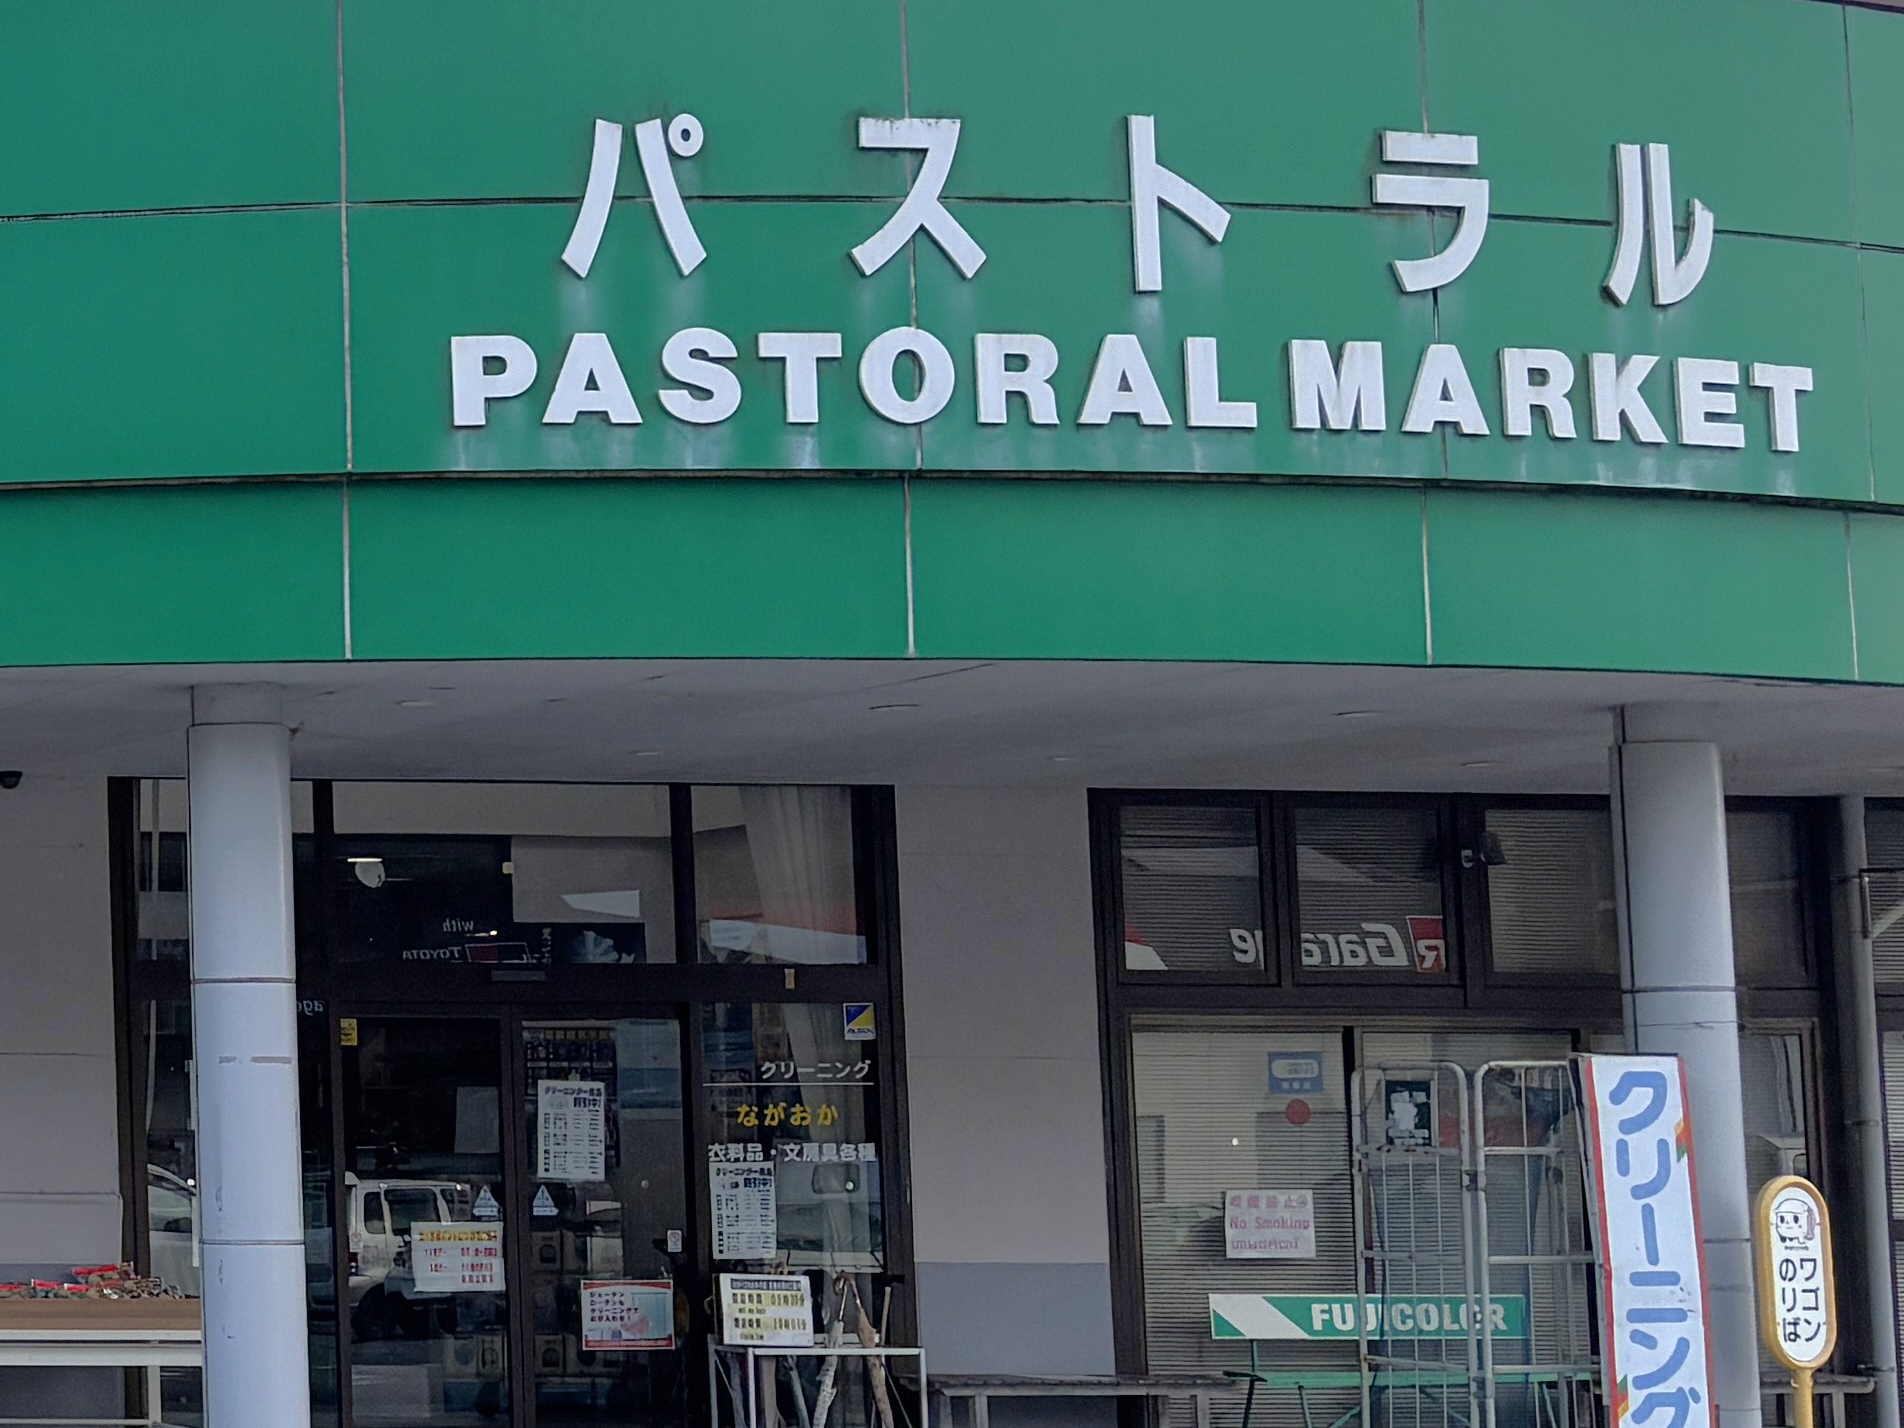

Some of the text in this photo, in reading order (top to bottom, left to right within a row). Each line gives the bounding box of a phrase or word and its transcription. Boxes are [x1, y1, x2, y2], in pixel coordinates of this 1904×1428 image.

[562, 113, 1715, 307] パストラル
[449, 326, 1813, 453] PASTORAL MARKET
[761, 1060, 872, 1079] クリーニング
[737, 1102, 839, 1127] ながおか
[1230, 1215, 1311, 1230] No Smoking
[1310, 1303, 1508, 1332] FUJICOLOR
[1779, 1257, 1802, 1343] のりば
[1799, 1257, 1821, 1342] ワゴン
